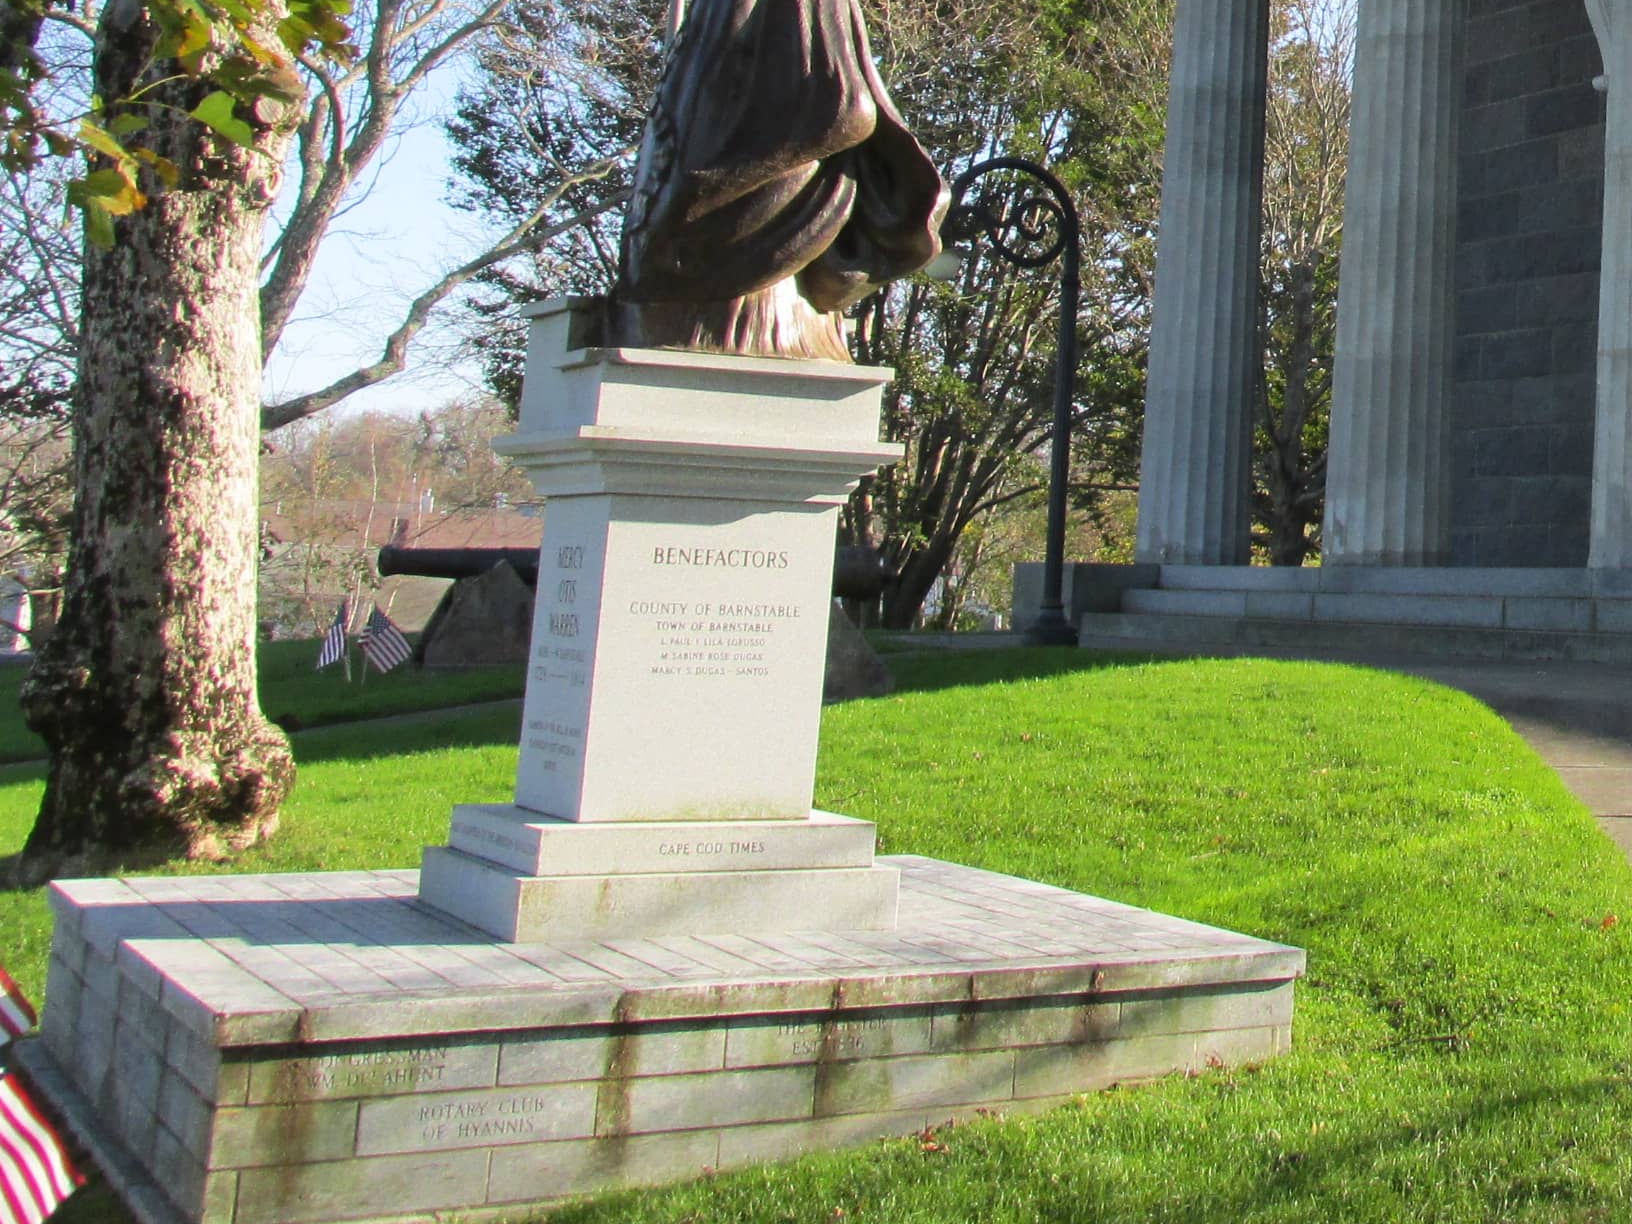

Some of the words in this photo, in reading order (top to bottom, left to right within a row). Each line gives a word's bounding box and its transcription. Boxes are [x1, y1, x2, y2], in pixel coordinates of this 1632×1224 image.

[653, 546, 789, 569] BENEFACTORS
[629, 601, 688, 615] COUNTY
[695, 603, 713, 616] OF
[719, 604, 801, 618] BARNSTABLE
[655, 620, 686, 632] TOWN
[690, 621, 705, 632] OF
[708, 622, 774, 633] BARNSTABLE
[658, 842, 689, 855] CAPE
[696, 842, 723, 854] COD
[729, 841, 765, 854] TIMES
[419, 1100, 488, 1121] ROTARY
[499, 1096, 545, 1114] CLUB
[422, 1125, 449, 1140] OF
[457, 1116, 535, 1138] HYANNIS
